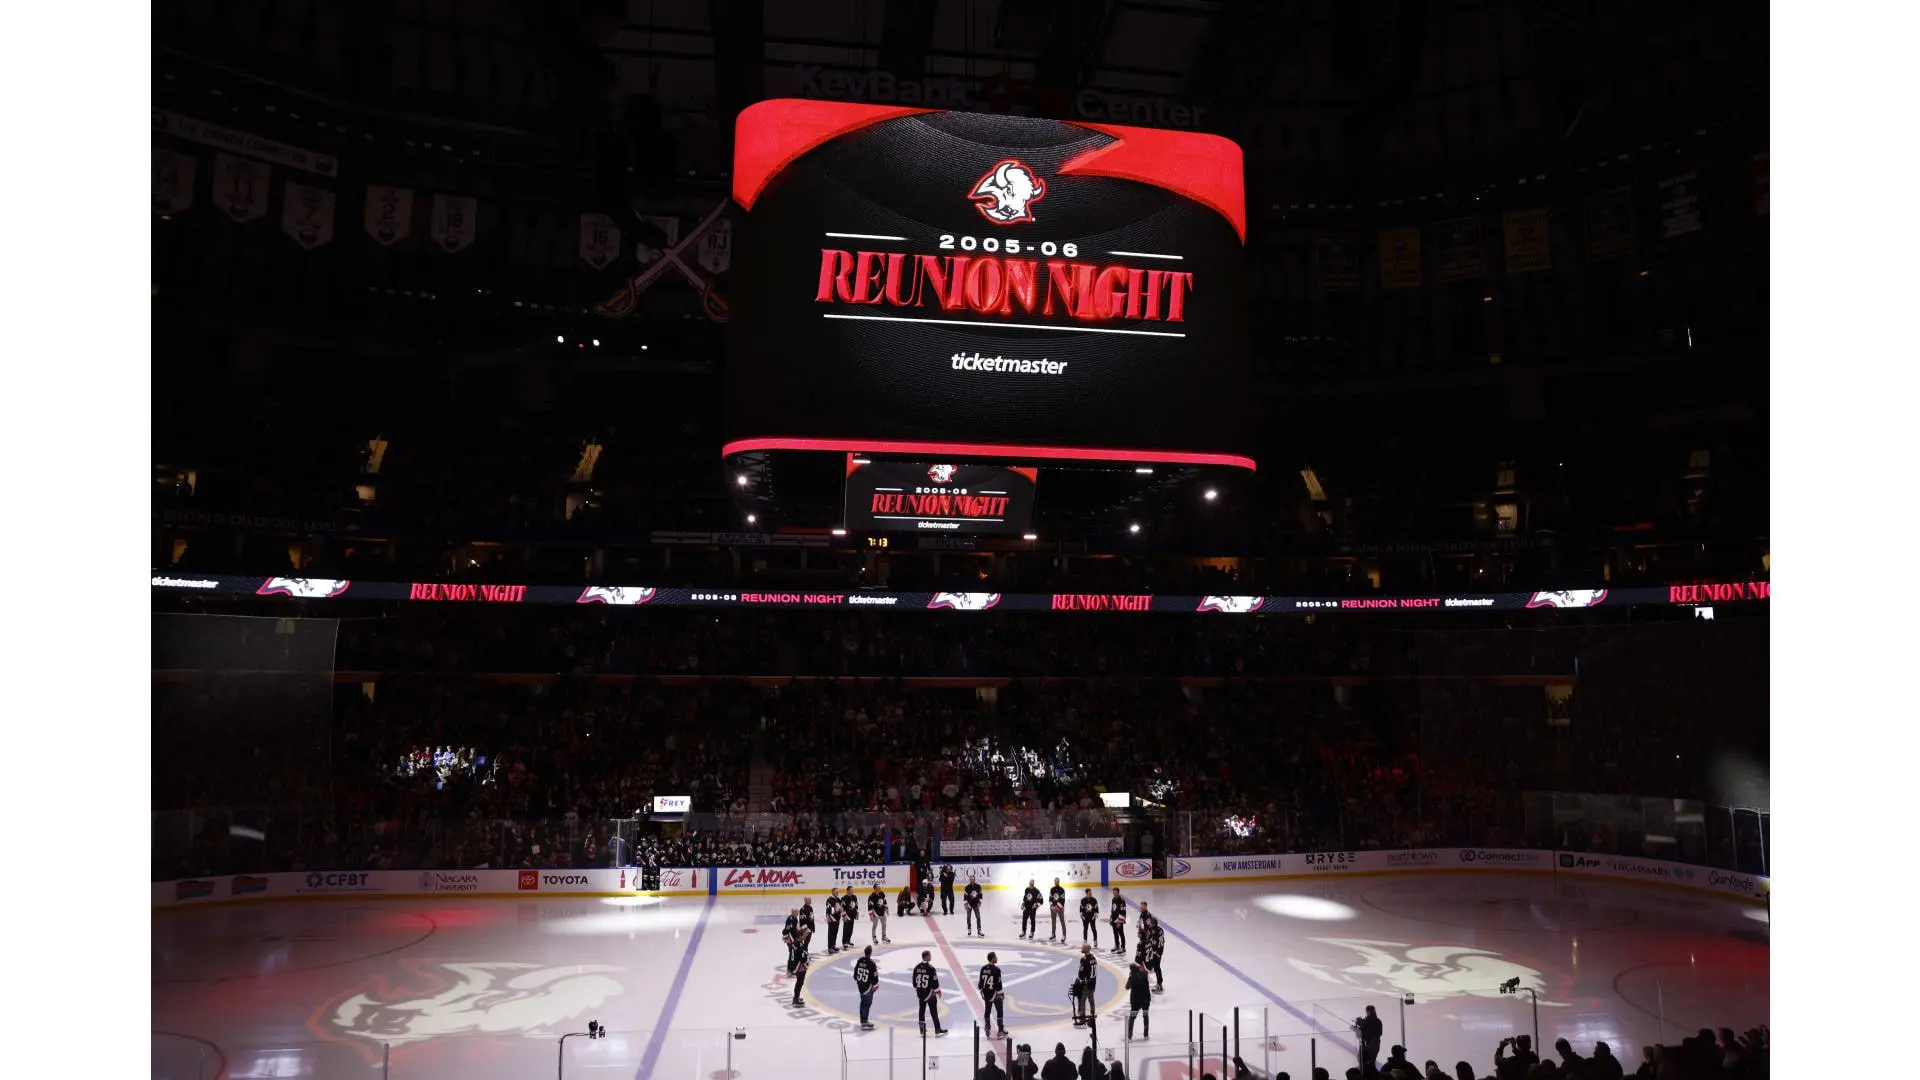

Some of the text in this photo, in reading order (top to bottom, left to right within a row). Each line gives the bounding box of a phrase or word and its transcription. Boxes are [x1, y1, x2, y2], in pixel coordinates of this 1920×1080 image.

[1076, 88, 1208, 127] Center
[381, 203, 396, 220] 2
[446, 212, 464, 228] 18
[707, 234, 728, 250] RJ
[939, 234, 1078, 258] 2005-06
[815, 249, 1194, 322] REUNION NIGHT
[951, 352, 1068, 375] ticketmaster
[916, 486, 968, 495] 2005-06
[871, 493, 1010, 517] REUNION NIGHT
[917, 521, 961, 530] ticketmaster
[868, 537, 889, 548] 7:13
[410, 583, 527, 602] REUNION NIGHT
[741, 593, 800, 603] REUNION
[803, 594, 844, 604] NIGHT
[849, 594, 898, 605] ticketmaster
[1669, 583, 1744, 603] REUNION
[1051, 594, 1152, 611] REUNION NIGHT
[1341, 600, 1397, 608] REUNION
[1401, 598, 1440, 608] NIGHT
[664, 799, 685, 807] FREY
[1223, 859, 1277, 871] NEW AMSTERDAM
[1318, 852, 1356, 864] RYSE
[326, 873, 369, 887] CFBT
[435, 872, 478, 883] NIAGARA
[543, 875, 588, 885] TOYOTA
[724, 868, 803, 886] LA NOVA
[833, 867, 885, 880] Trusted
[856, 967, 870, 983] 55
[915, 974, 929, 989] 45
[981, 974, 994, 990] 74
